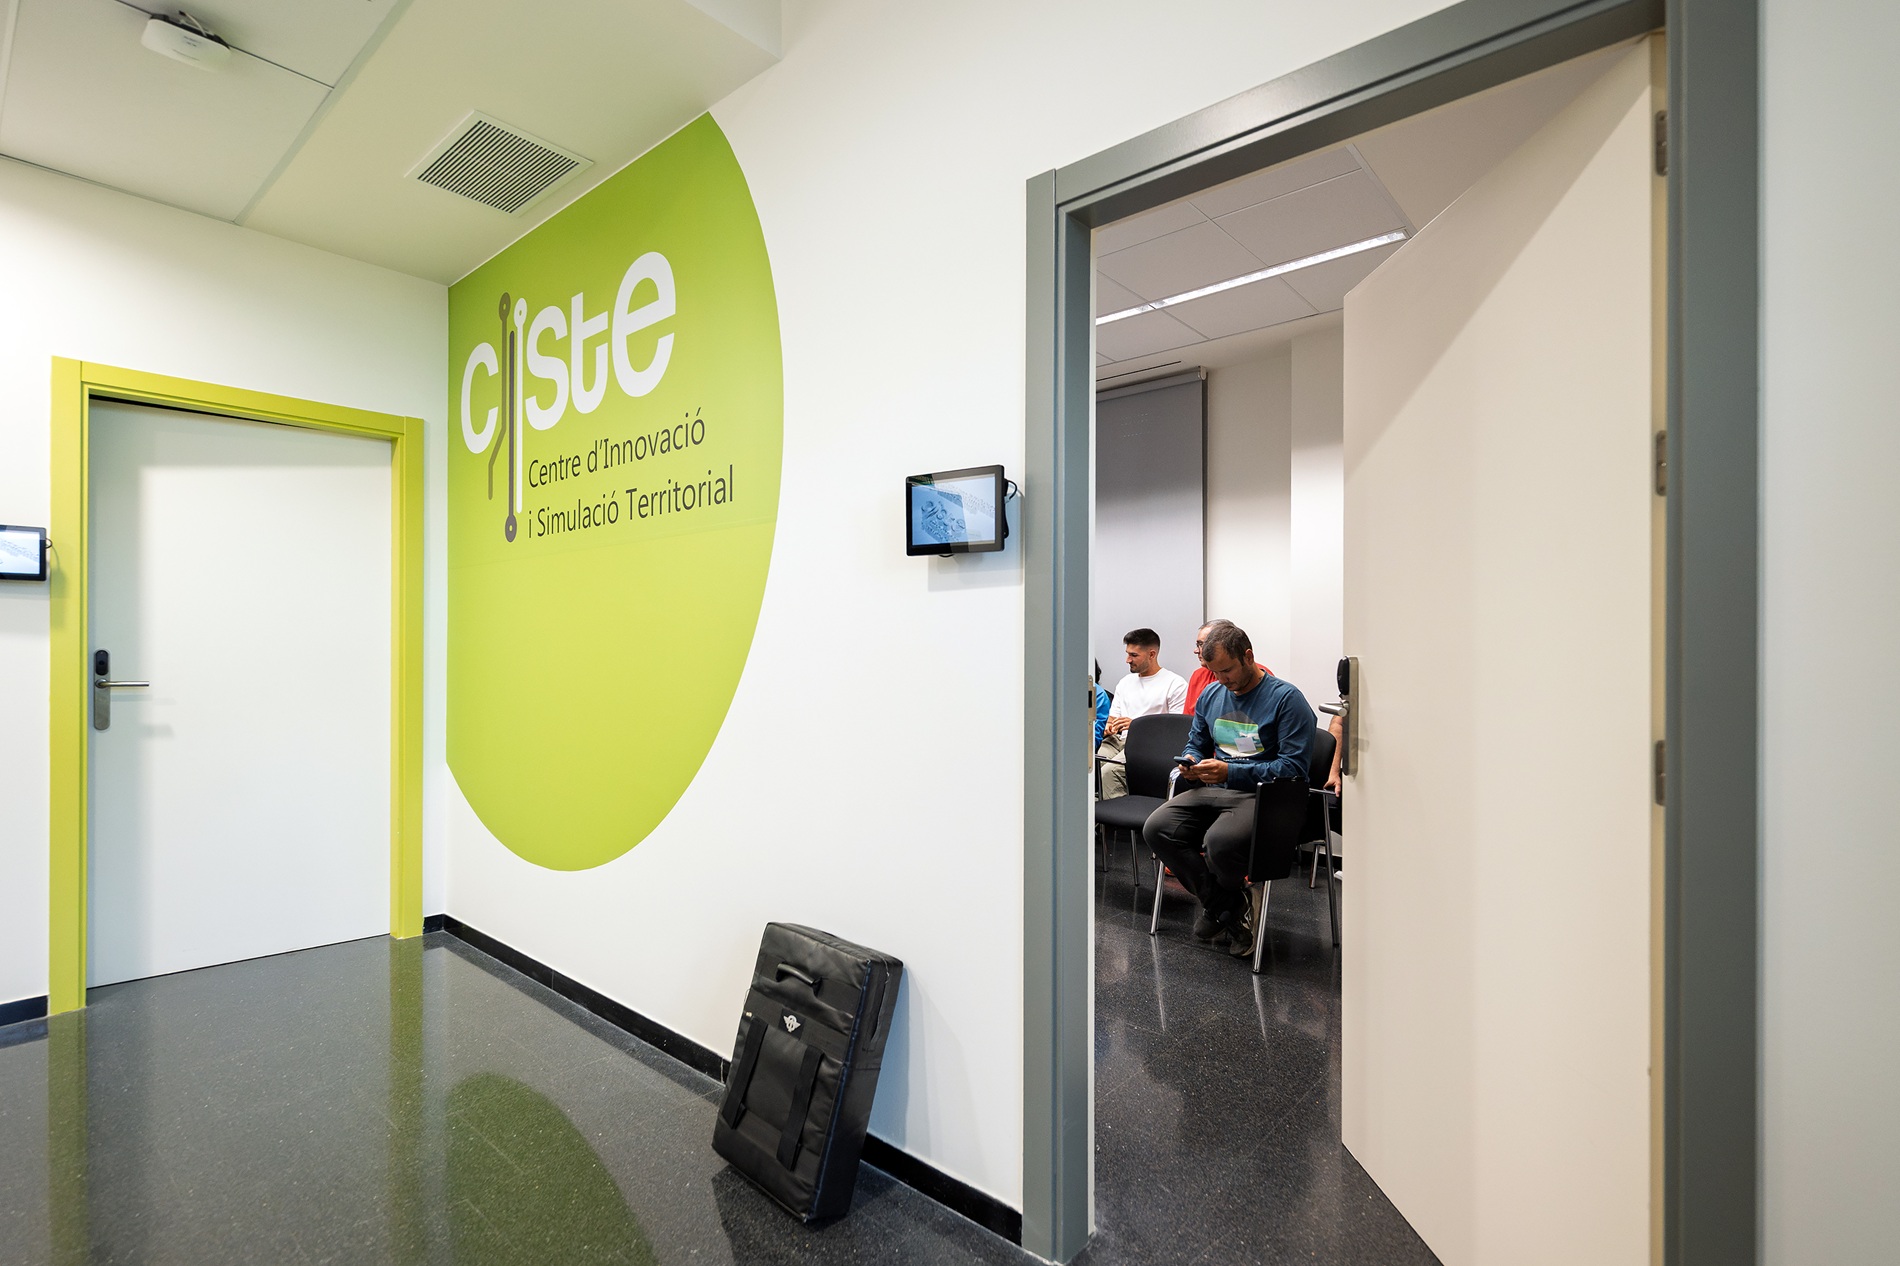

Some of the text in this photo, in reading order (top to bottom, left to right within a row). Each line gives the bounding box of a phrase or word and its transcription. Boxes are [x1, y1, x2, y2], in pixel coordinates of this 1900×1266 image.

[528, 407, 705, 488] Centre d'Innovació
[528, 464, 734, 539] i Simulació Territorial
